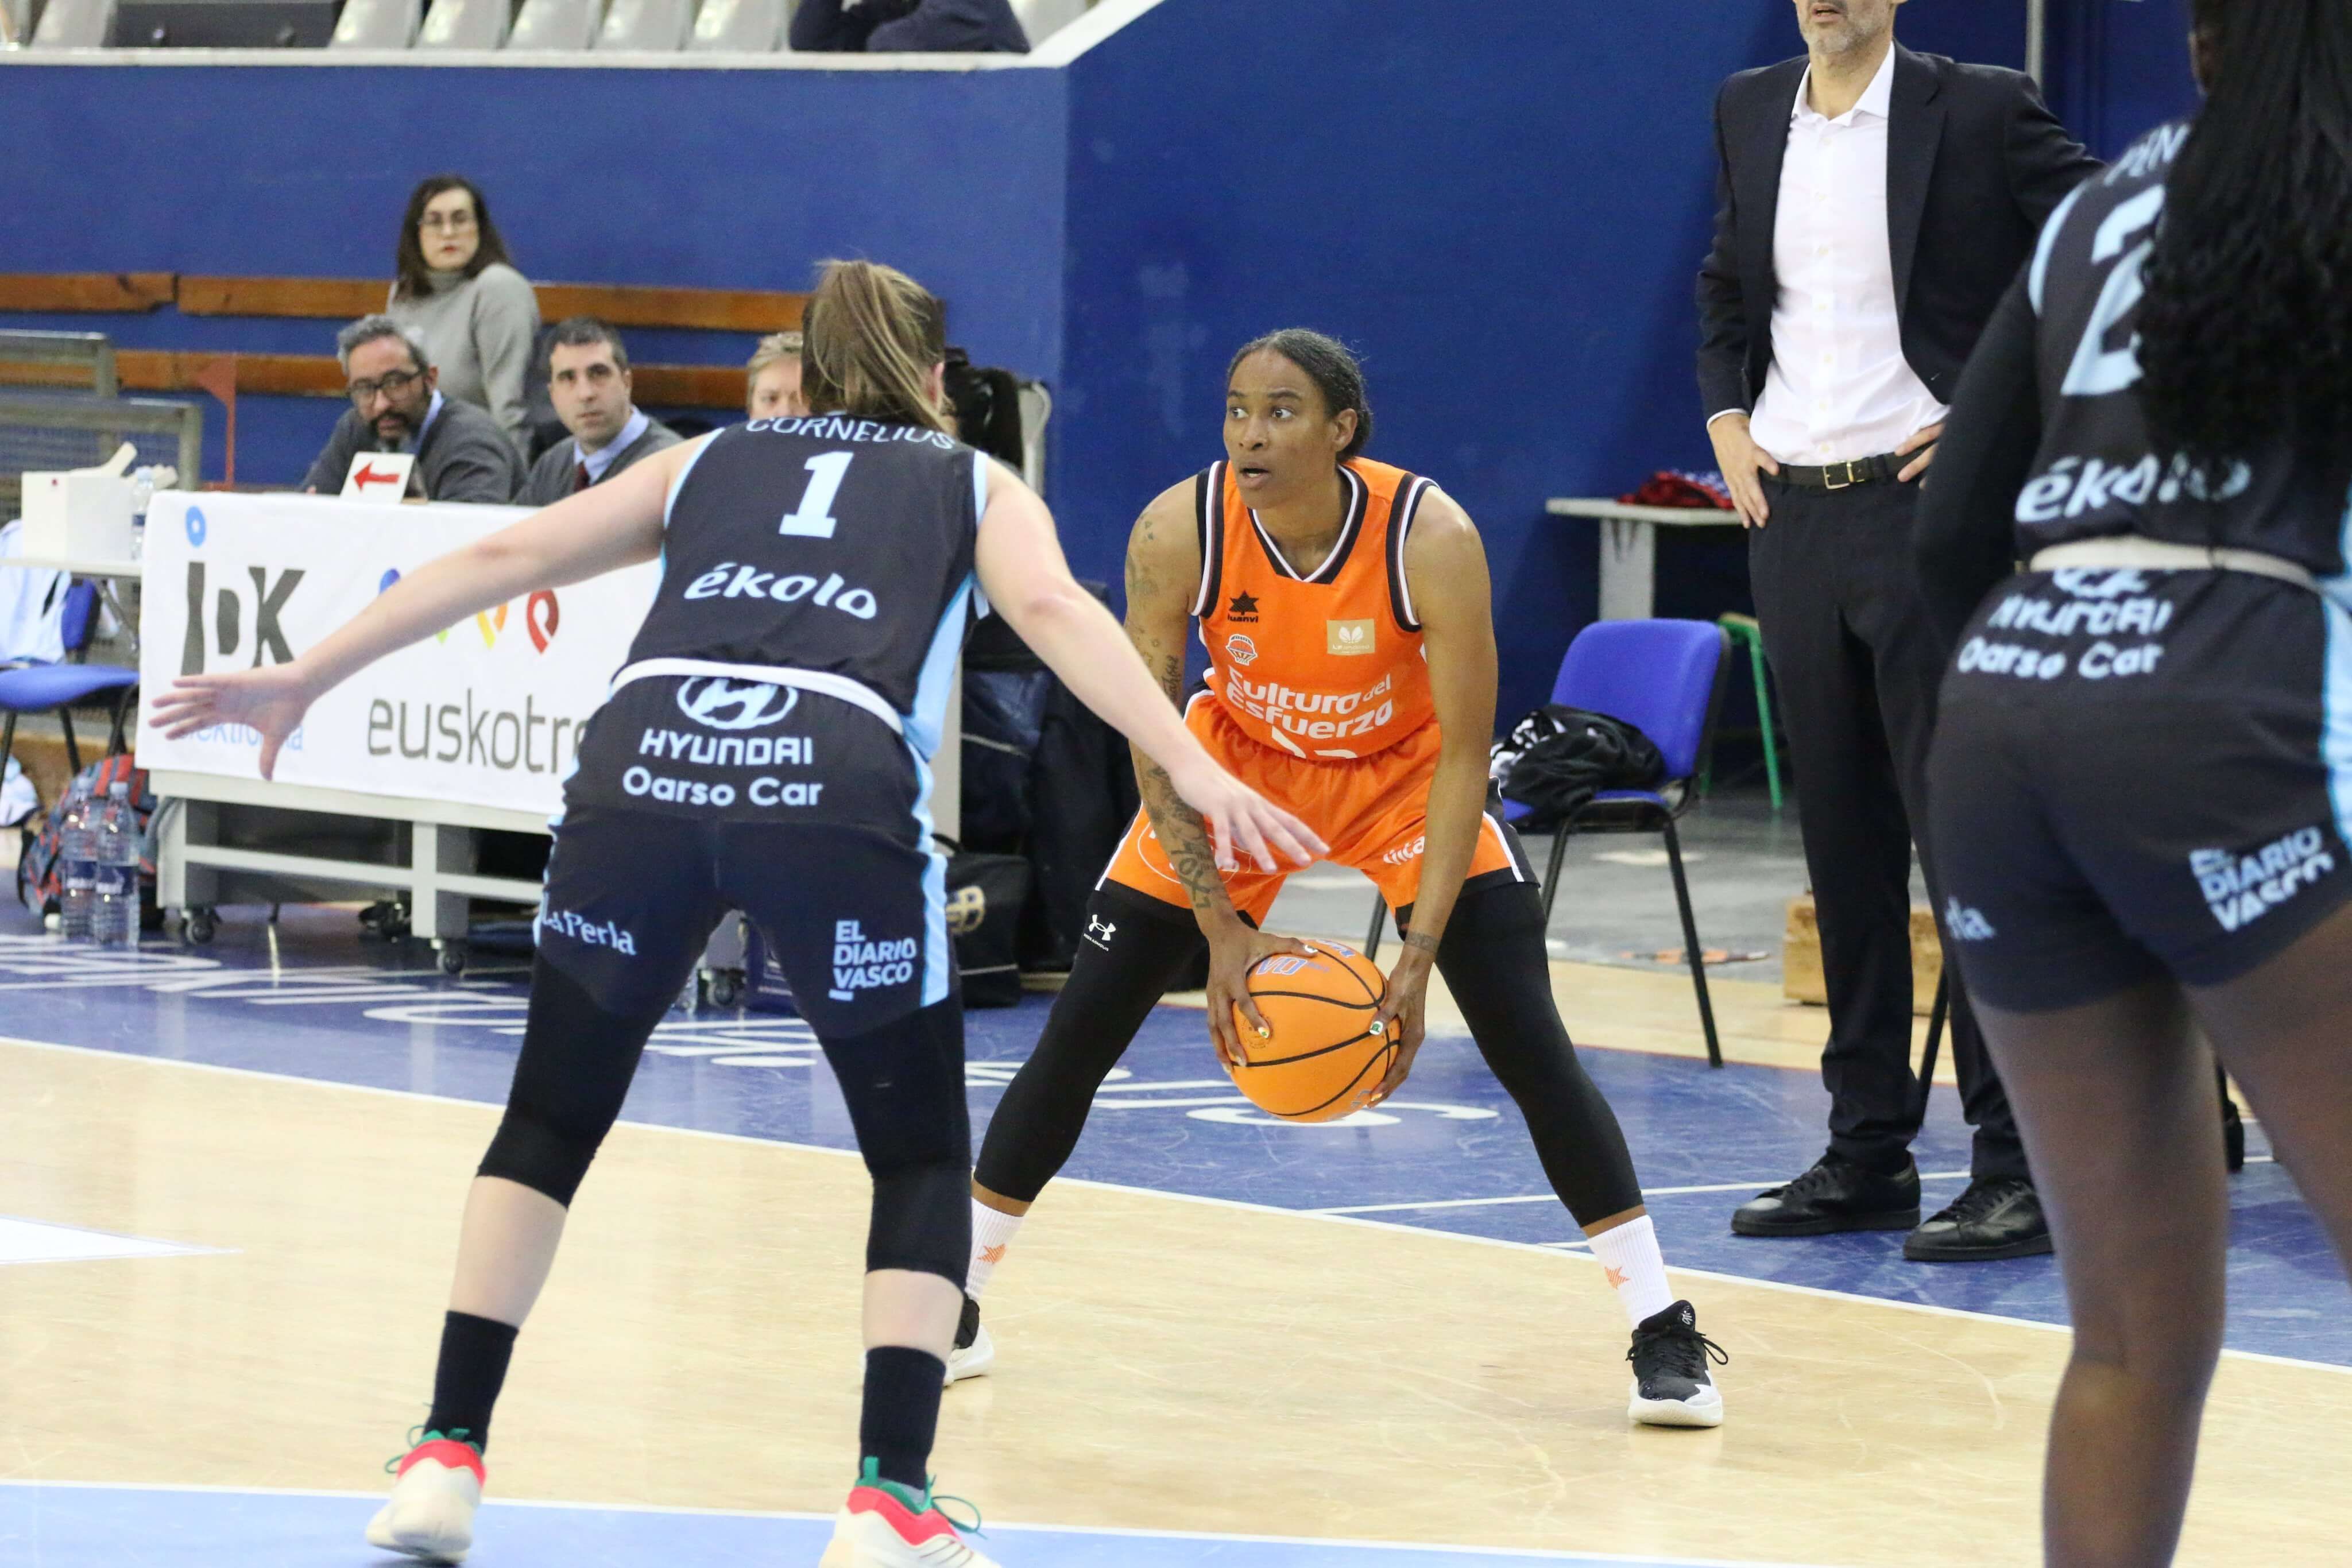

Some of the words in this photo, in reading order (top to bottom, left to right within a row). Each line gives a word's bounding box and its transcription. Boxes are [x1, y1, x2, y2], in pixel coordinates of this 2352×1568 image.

[746, 416, 956, 450] CORNELIUS
[779, 452, 854, 538] 1
[684, 562, 877, 620] ékolo
[1227, 613, 1259, 623] luanvi
[1958, 636, 2066, 679] Oarso
[2078, 641, 2164, 679] Car
[1363, 672, 1391, 702] del
[1226, 681, 1393, 740] Esfuerzo
[639, 727, 813, 765] HYUNDAI
[622, 766, 735, 807] Oarso
[748, 777, 823, 806] Car
[2200, 826, 2323, 904] DIARIO
[562, 910, 637, 955] Perla
[835, 920, 866, 942] EL
[833, 937, 917, 966] DIARIO
[833, 961, 913, 990] VASCO
